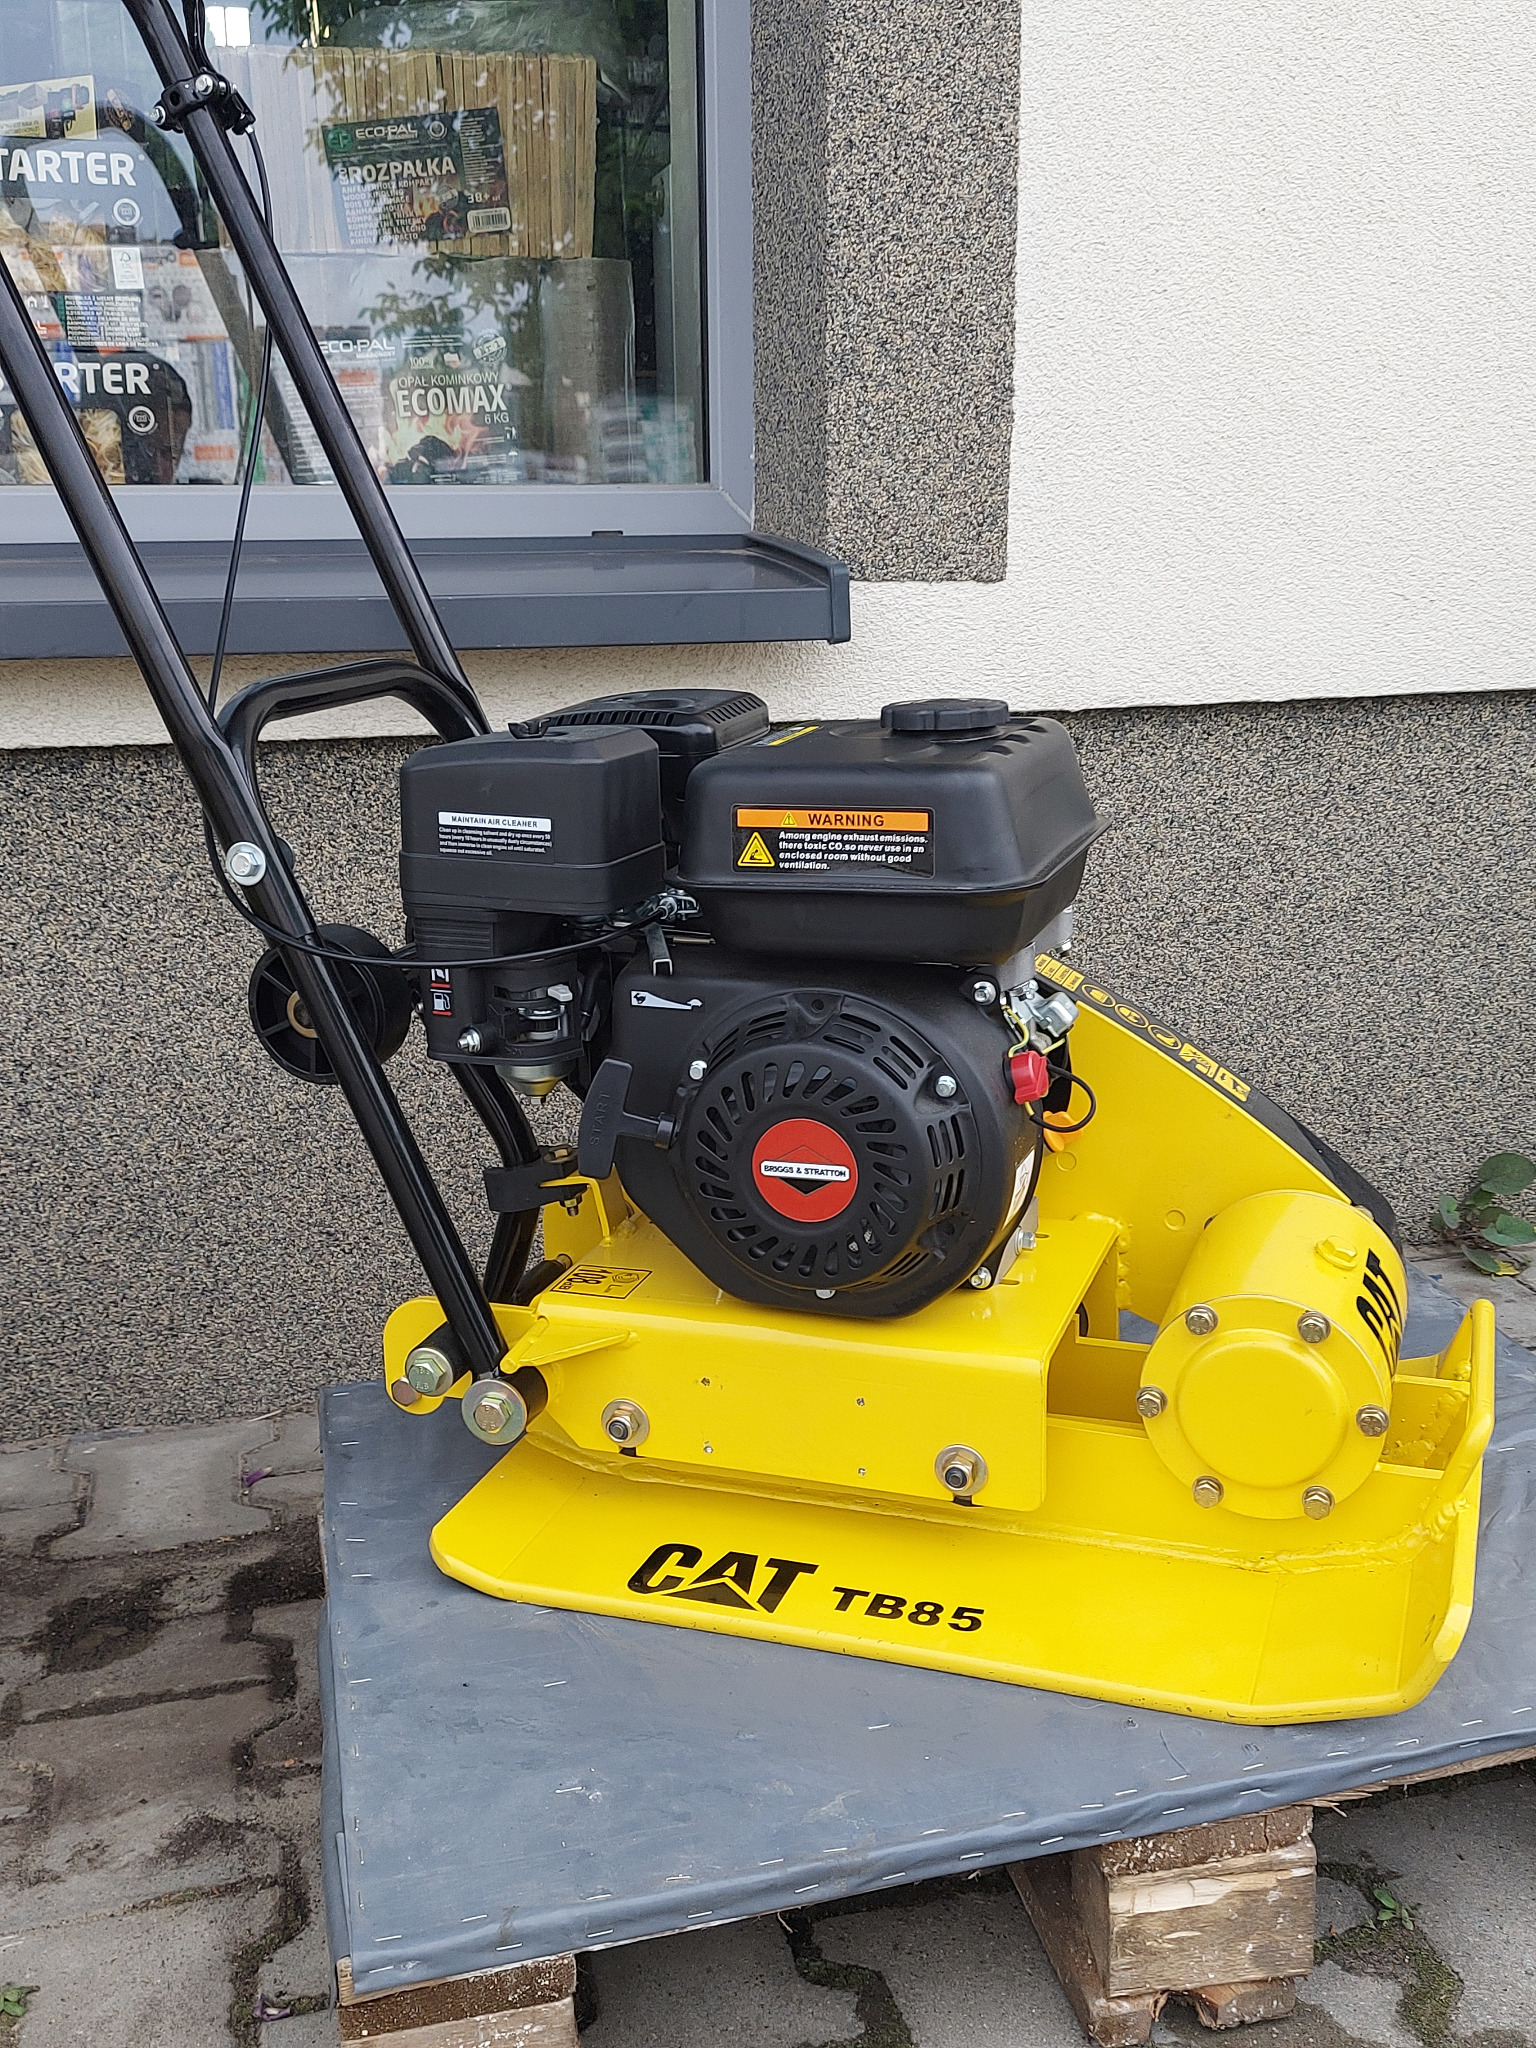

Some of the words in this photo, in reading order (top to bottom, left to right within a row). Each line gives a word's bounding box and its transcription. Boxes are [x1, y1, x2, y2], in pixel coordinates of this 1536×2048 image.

[348, 156, 456, 184] ROZPAŁKA
[53, 362, 151, 395] RTER
[398, 376, 429, 389] OPAŁ
[431, 372, 499, 387] KOMINKOWY
[396, 384, 508, 418] ECOMAX
[484, 413, 491, 424] 6
[493, 412, 510, 424] KG
[451, 816, 487, 824] MAINTAIN
[501, 820, 538, 828] CLEANER
[808, 813, 885, 827] WARNING
[779, 830, 811, 842] Among
[811, 832, 842, 842] engine
[843, 833, 879, 842] exhaust
[779, 841, 803, 851] there
[803, 842, 828, 851] toxic
[857, 844, 883, 852] never
[884, 845, 901, 853] use
[902, 844, 912, 853] in
[779, 851, 823, 861] enclosed
[823, 853, 849, 862] room
[849, 852, 887, 863] without
[887, 855, 912, 864] good
[779, 861, 831, 870] ventilation.
[590, 1091, 610, 1146] START
[764, 1165, 794, 1173] BRIGGS
[804, 1168, 847, 1178] STRATTON
[627, 1543, 820, 1614] CAT
[831, 1586, 985, 1632] TB85
